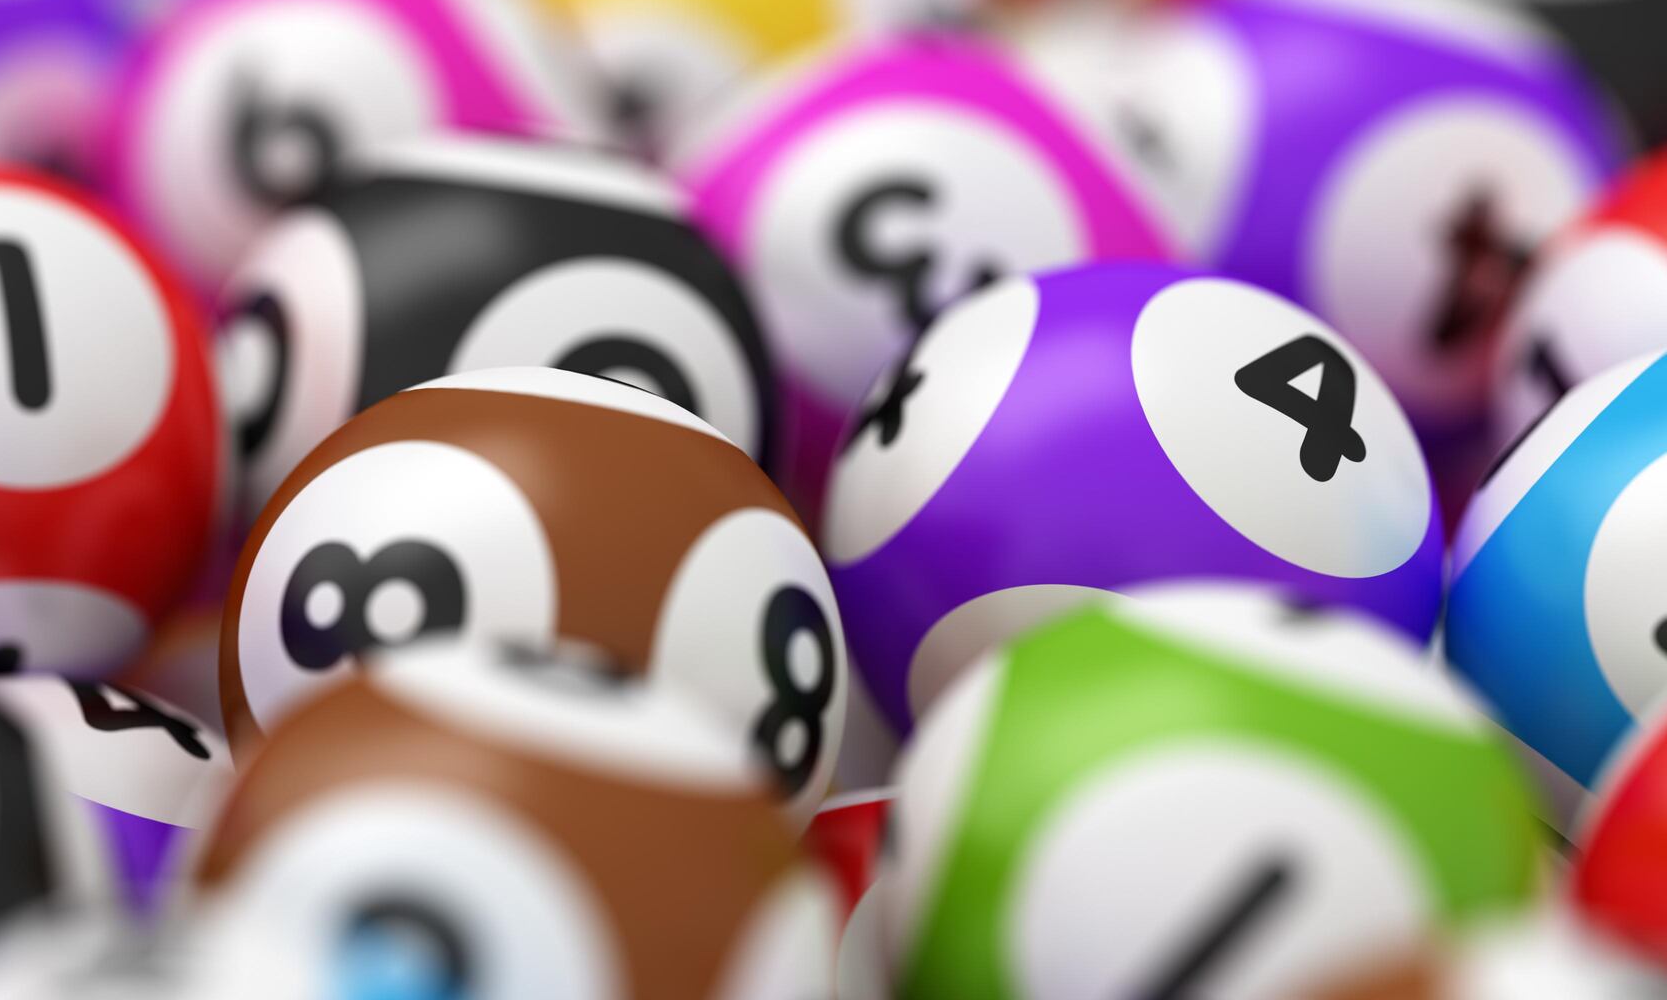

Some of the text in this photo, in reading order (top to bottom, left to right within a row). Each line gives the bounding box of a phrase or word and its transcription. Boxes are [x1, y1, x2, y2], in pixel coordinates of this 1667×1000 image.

[1234, 333, 1367, 483] 4
[279, 537, 469, 673] 8
[747, 580, 837, 807] 8
